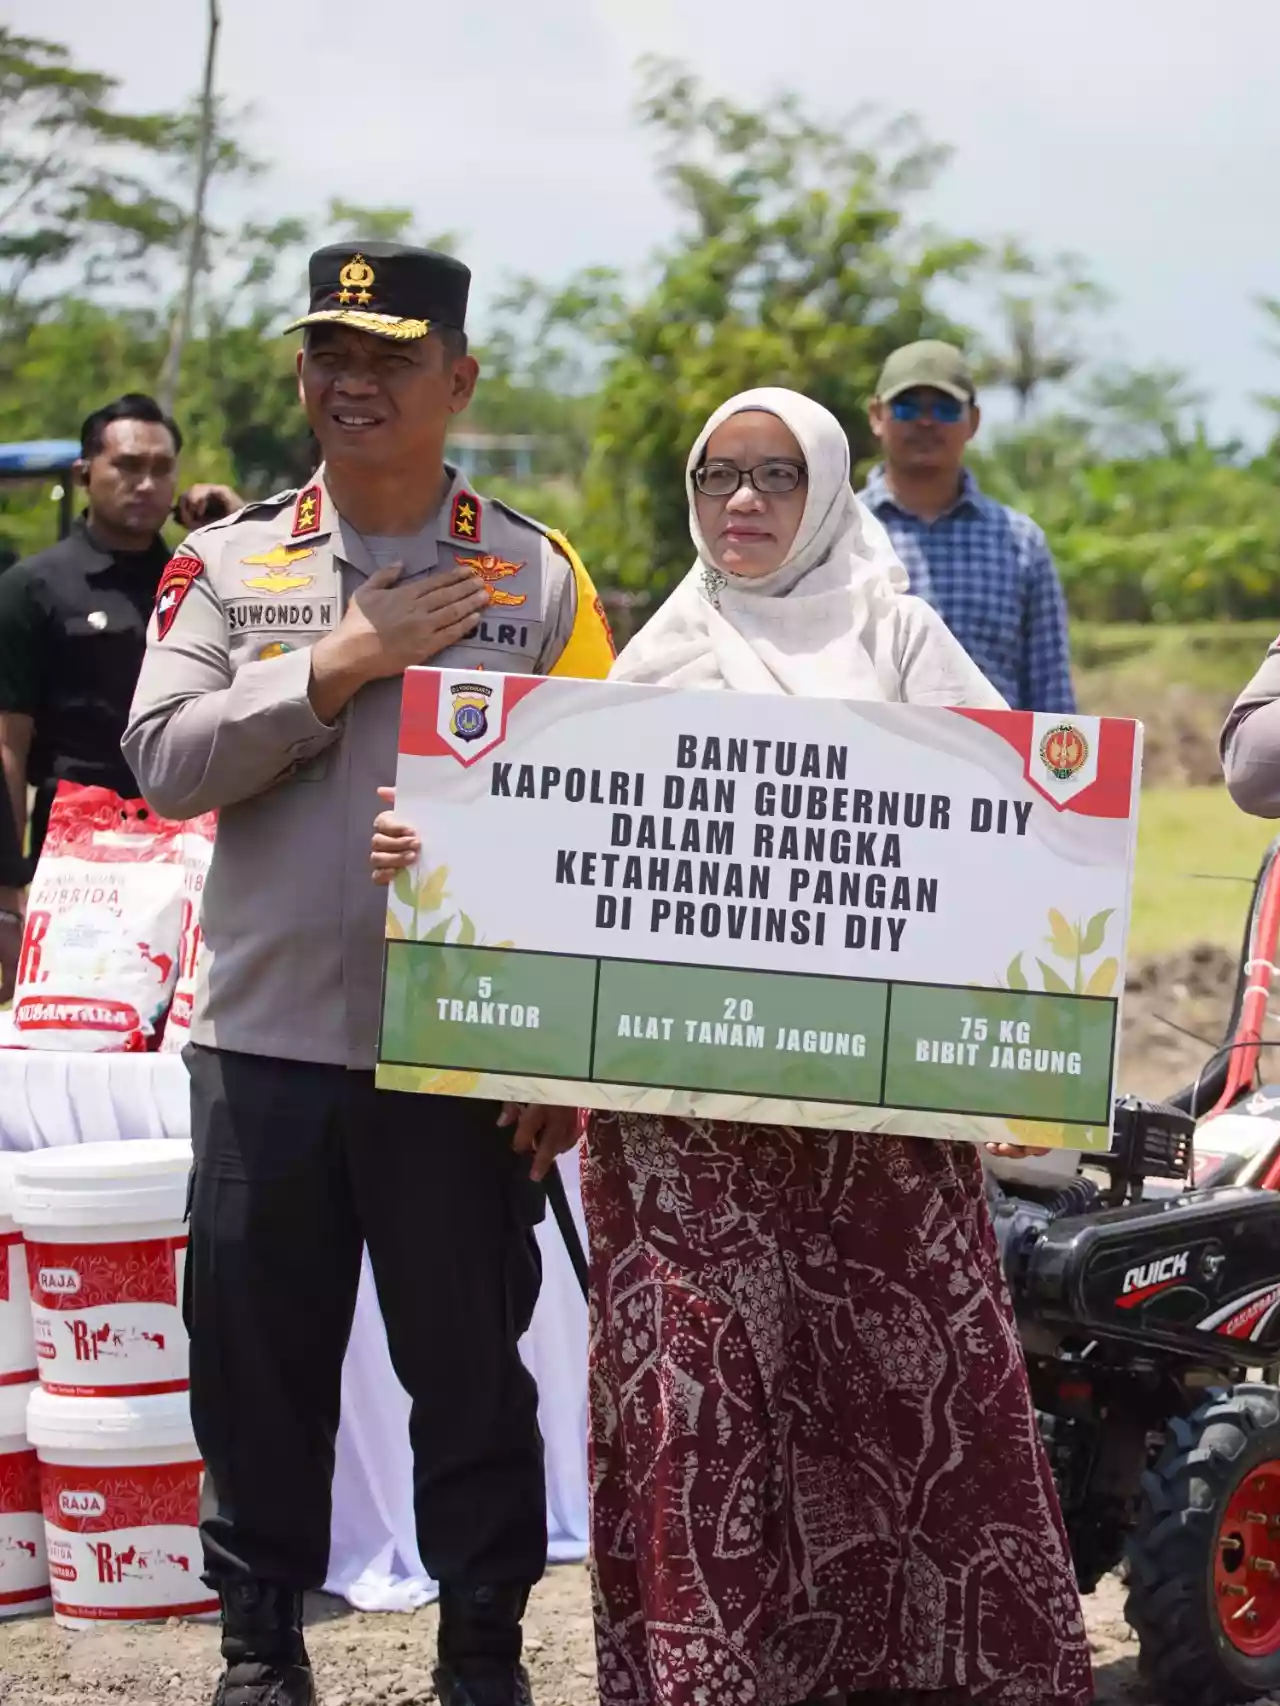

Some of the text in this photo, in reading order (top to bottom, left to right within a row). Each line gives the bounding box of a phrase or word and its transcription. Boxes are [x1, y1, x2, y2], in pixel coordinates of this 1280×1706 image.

[228, 604, 331, 629] SUWONDO N
[677, 735, 847, 780] BANTUAN
[492, 763, 1033, 835] KAPOLRI DAN GUBERNUR DIY
[611, 813, 900, 867] DALAM RANGKA
[36, 887, 119, 905] HIBRIDA
[556, 850, 937, 912] KETAHANAN PANGAN
[596, 895, 906, 951] DI PROVINSI DIY
[478, 977, 492, 999] 5
[18, 1003, 129, 1025] NUSANTARA
[437, 998, 539, 1028] TRAKTOR
[723, 998, 753, 1021] 20
[618, 1015, 866, 1057] ALAT TANAM JAGUNG
[961, 1017, 1030, 1044] 75 KG
[916, 1039, 1081, 1074] BIBIT JAGUNG
[41, 1273, 77, 1288] RAJA
[1123, 1250, 1190, 1292] QUICK
[61, 1495, 101, 1511] RAJA
